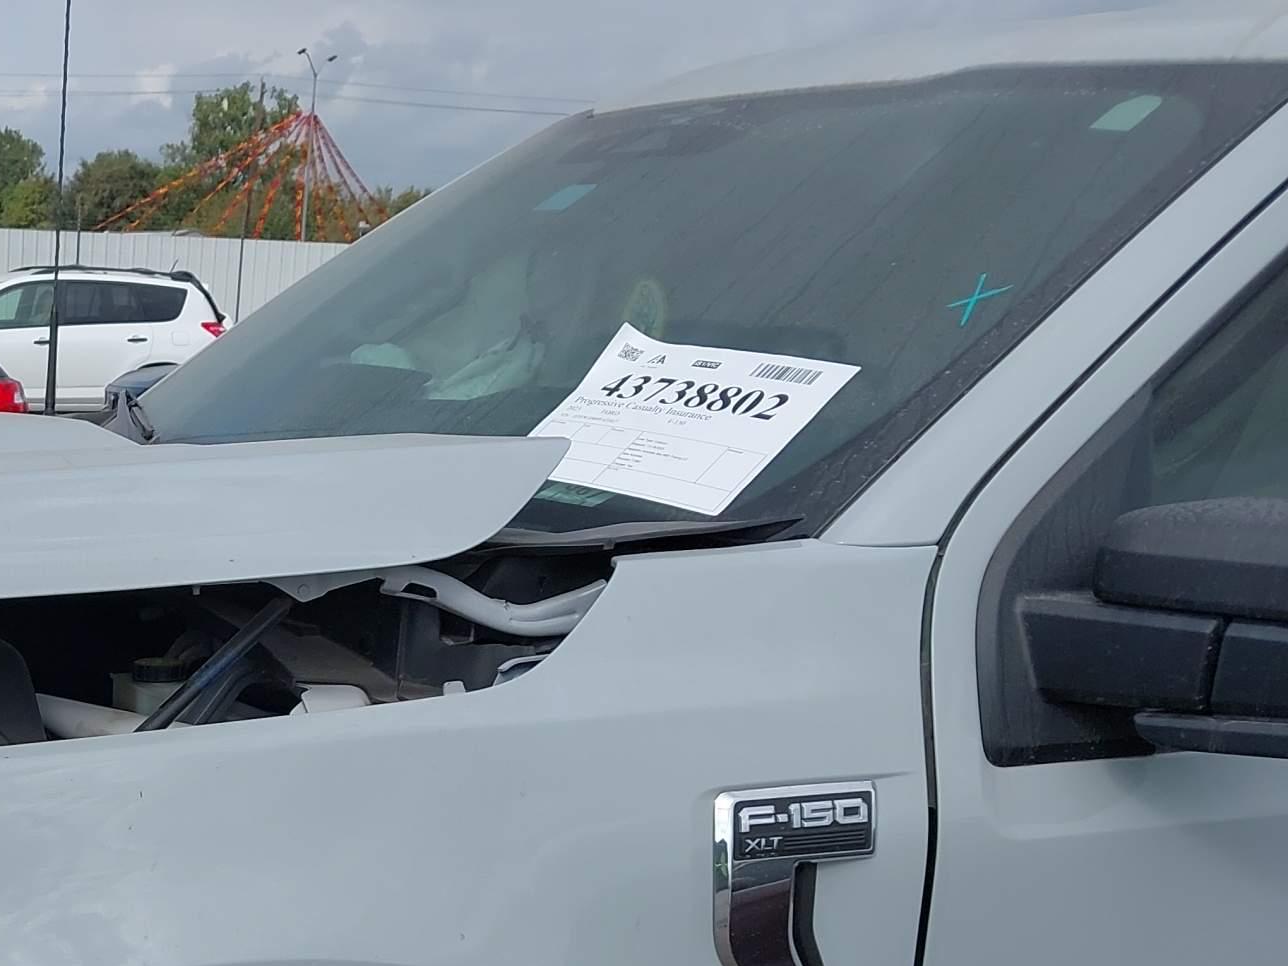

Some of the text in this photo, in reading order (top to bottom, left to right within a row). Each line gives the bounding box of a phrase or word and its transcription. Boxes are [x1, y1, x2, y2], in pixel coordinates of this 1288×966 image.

[574, 396, 632, 410] Progressive
[625, 401, 665, 415] Casualty
[665, 405, 713, 421] Insurance
[600, 373, 790, 421] 43738802
[738, 797, 869, 833] F-150
[744, 836, 783, 853] XLT
